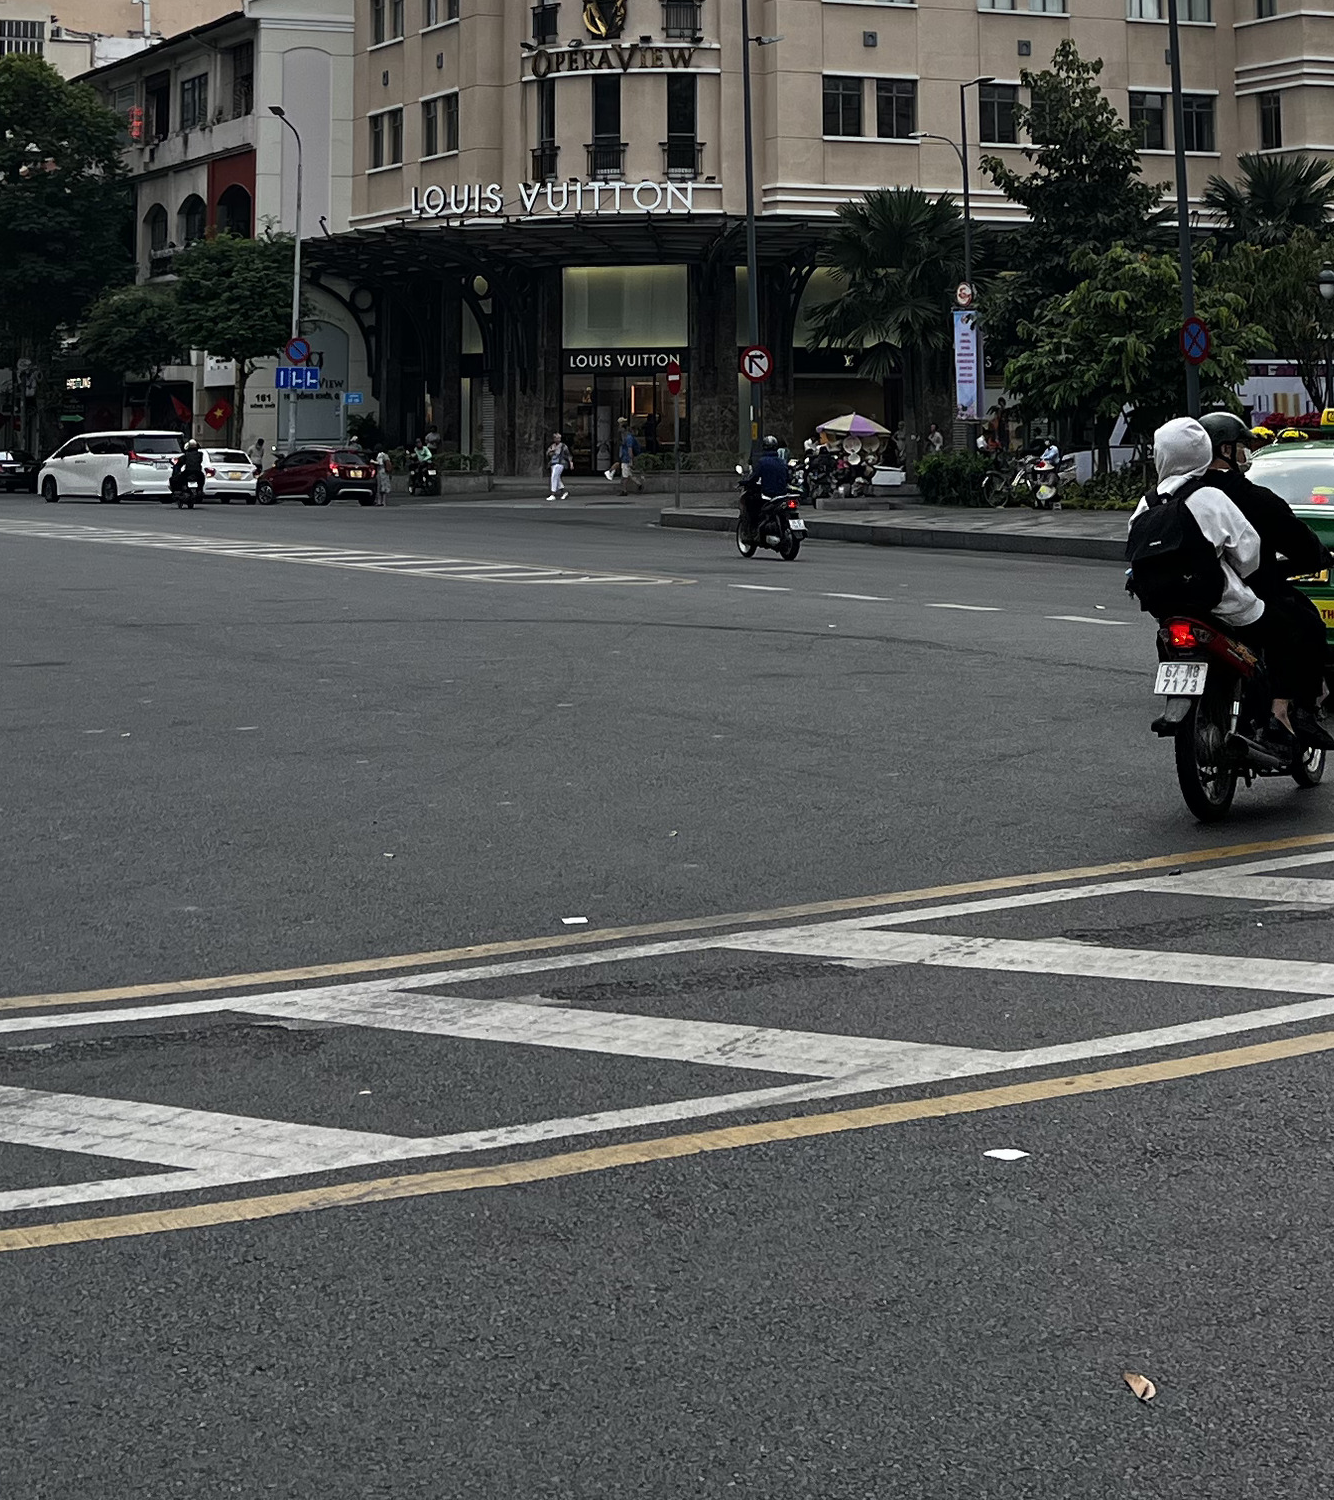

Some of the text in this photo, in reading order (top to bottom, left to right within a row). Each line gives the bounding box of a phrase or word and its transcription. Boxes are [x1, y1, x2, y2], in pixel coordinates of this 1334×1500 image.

[411, 180, 695, 215] LOUIS VUITTON
[569, 353, 680, 368] LOUIS VUITTON
[1162, 678, 1198, 693] 7173
